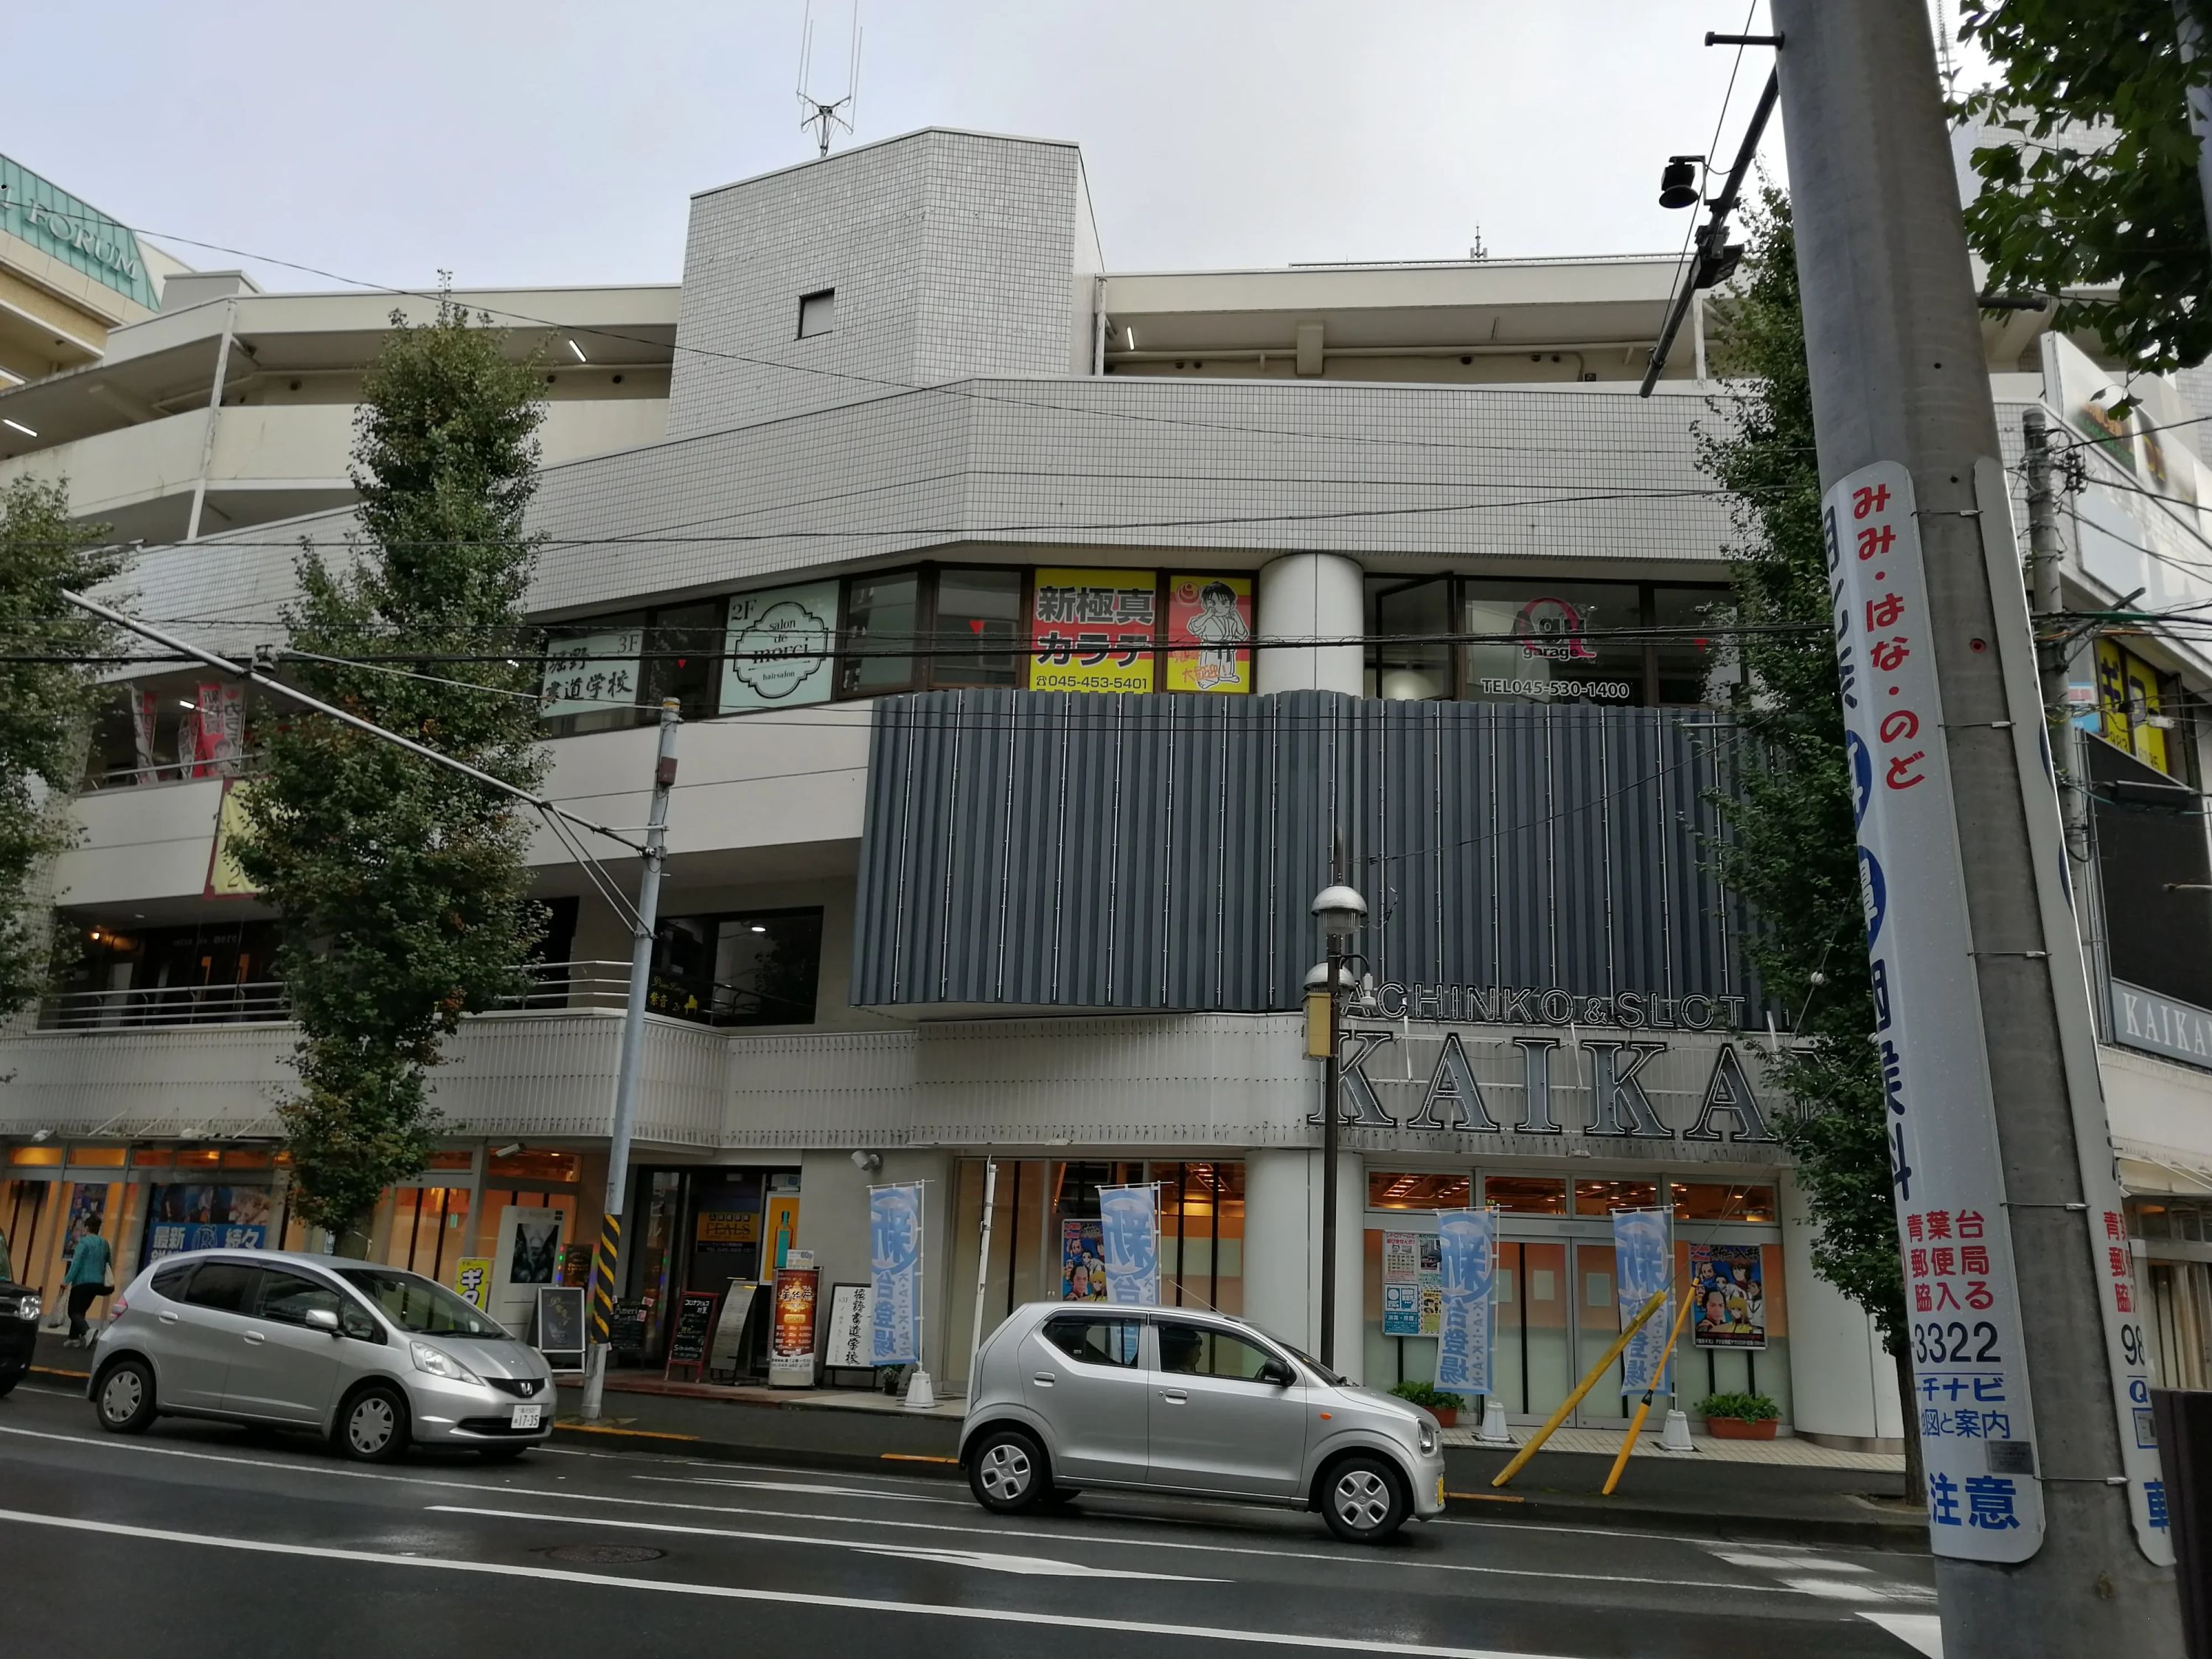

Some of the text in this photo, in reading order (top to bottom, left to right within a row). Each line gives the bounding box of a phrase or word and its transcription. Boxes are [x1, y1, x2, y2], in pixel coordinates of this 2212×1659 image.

[24, 198, 138, 282] FORUM
[731, 599, 757, 621] 2F
[1037, 585, 1155, 625] 新極真
[769, 619, 796, 630] salon
[618, 634, 639, 653] 3F
[1036, 632, 1150, 668] カラテ
[1523, 647, 1580, 661] garage
[762, 671, 796, 681] hairsalon
[1048, 676, 1148, 690] 045-453-5401
[1481, 678, 1630, 698] TEL045-530-1400
[153, 1225, 186, 1250] 最新
[1907, 1209, 1985, 1243] 青葉台
[1910, 1246, 1989, 1277] 郵便局
[1928, 1472, 2021, 1531] 注意
